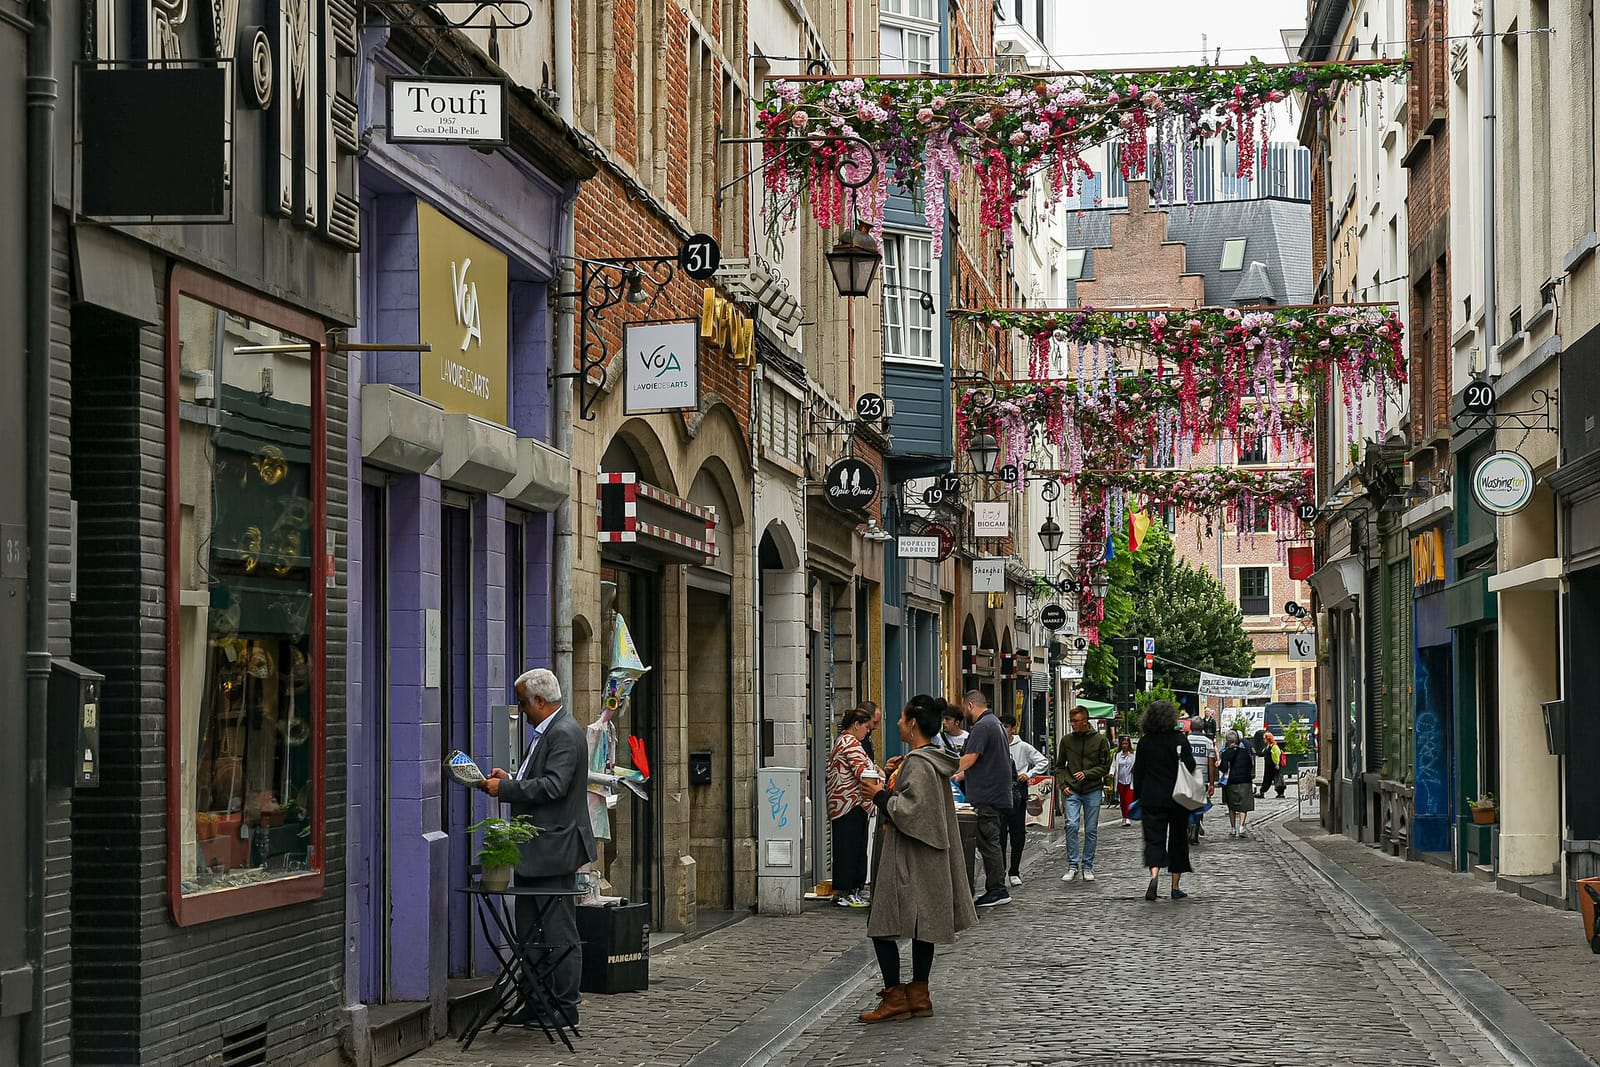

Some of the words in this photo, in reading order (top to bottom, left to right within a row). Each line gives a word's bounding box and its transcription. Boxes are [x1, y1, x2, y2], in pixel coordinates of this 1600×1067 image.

[408, 87, 488, 115] Toufi
[439, 117, 456, 125] 1957
[416, 125, 435, 133] Casa
[438, 126, 458, 134] Della
[461, 127, 480, 135] Pelle
[687, 243, 713, 272] 31
[1469, 387, 1492, 406] 20
[860, 398, 881, 415] 23
[1004, 468, 1016, 480] 15
[944, 478, 958, 491] 17
[1482, 477, 1525, 492] Washington
[928, 489, 943, 504] 19
[1302, 509, 1314, 519] 12
[7, 539, 20, 563] 35
[974, 566, 1003, 577] Shanghai
[986, 578, 991, 586] 7
[1064, 581, 1070, 591] 5
[1074, 583, 1081, 592] 3
[1288, 603, 1295, 613] 6
